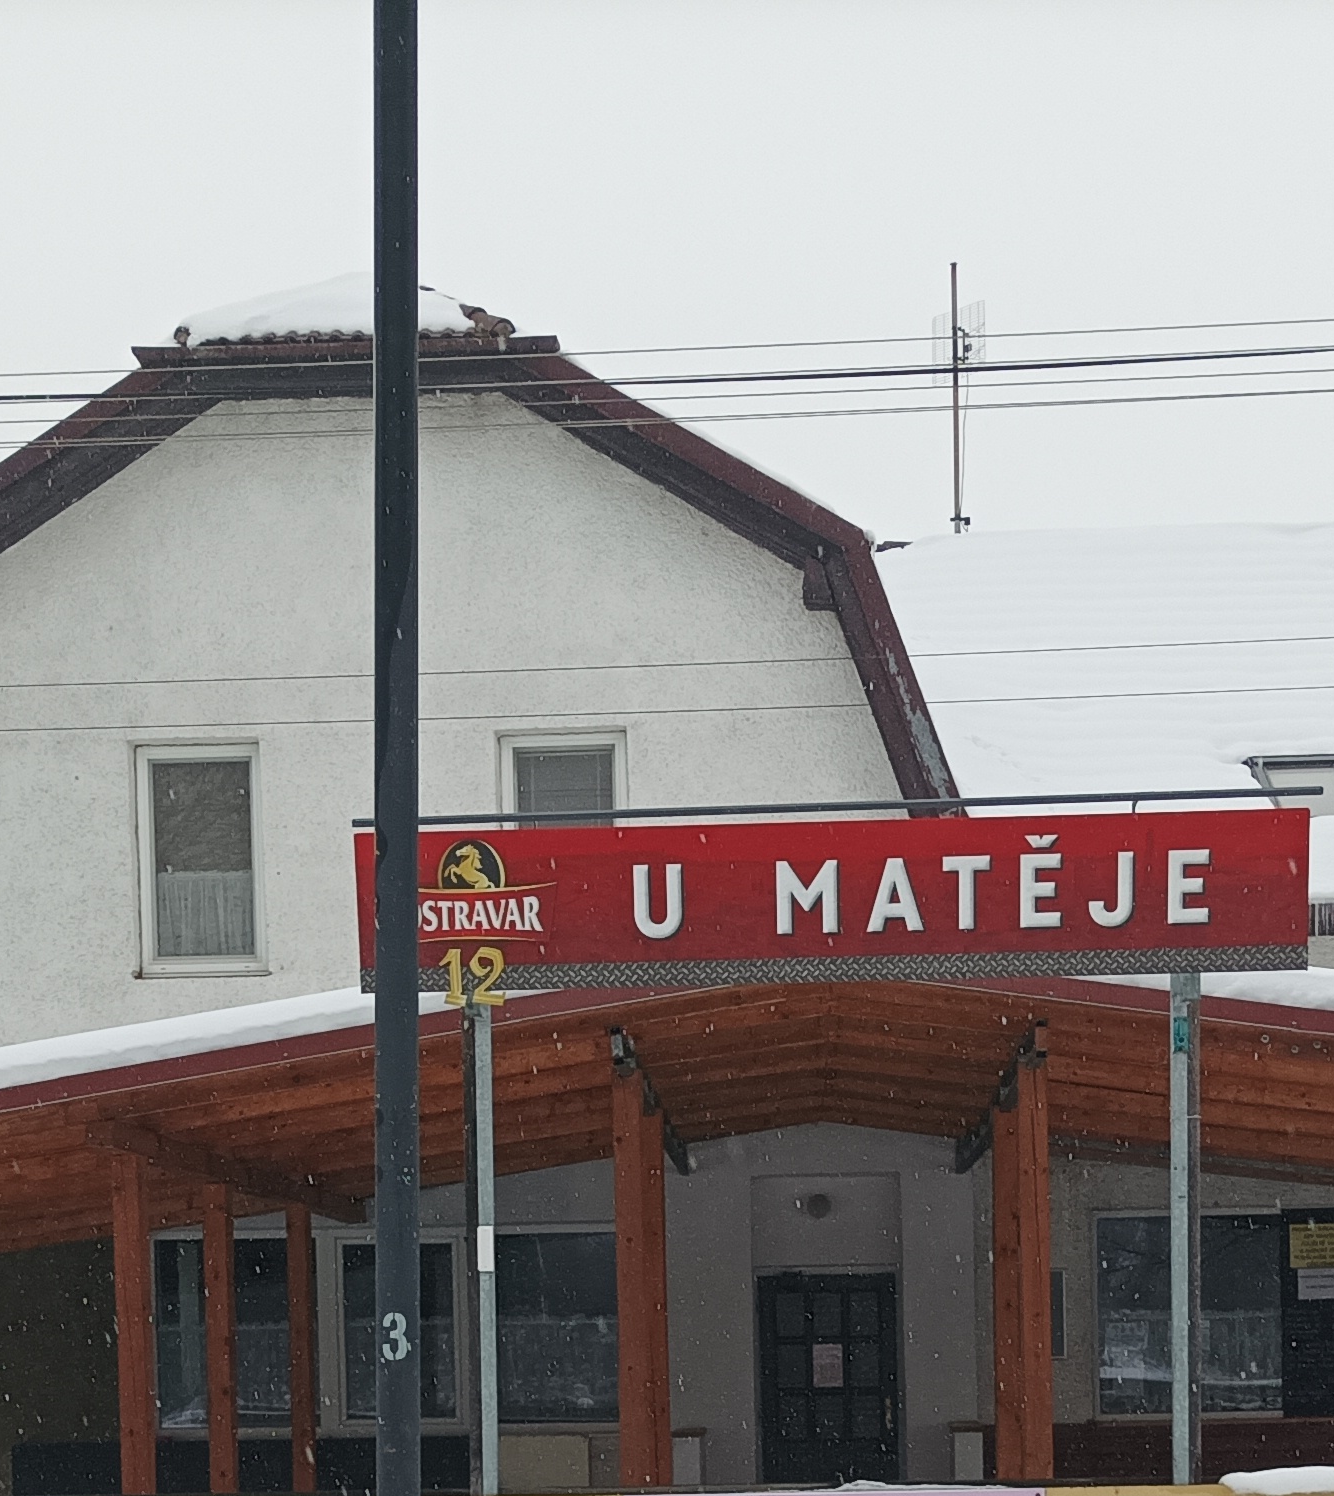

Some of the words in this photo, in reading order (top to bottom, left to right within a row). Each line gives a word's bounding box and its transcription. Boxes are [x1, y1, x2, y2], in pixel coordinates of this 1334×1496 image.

[418, 895, 544, 932] STRAVAR
[631, 862, 683, 939] U
[774, 833, 1210, 935] MATĚJE
[438, 946, 506, 1007] 12
[382, 1312, 408, 1361] 3
